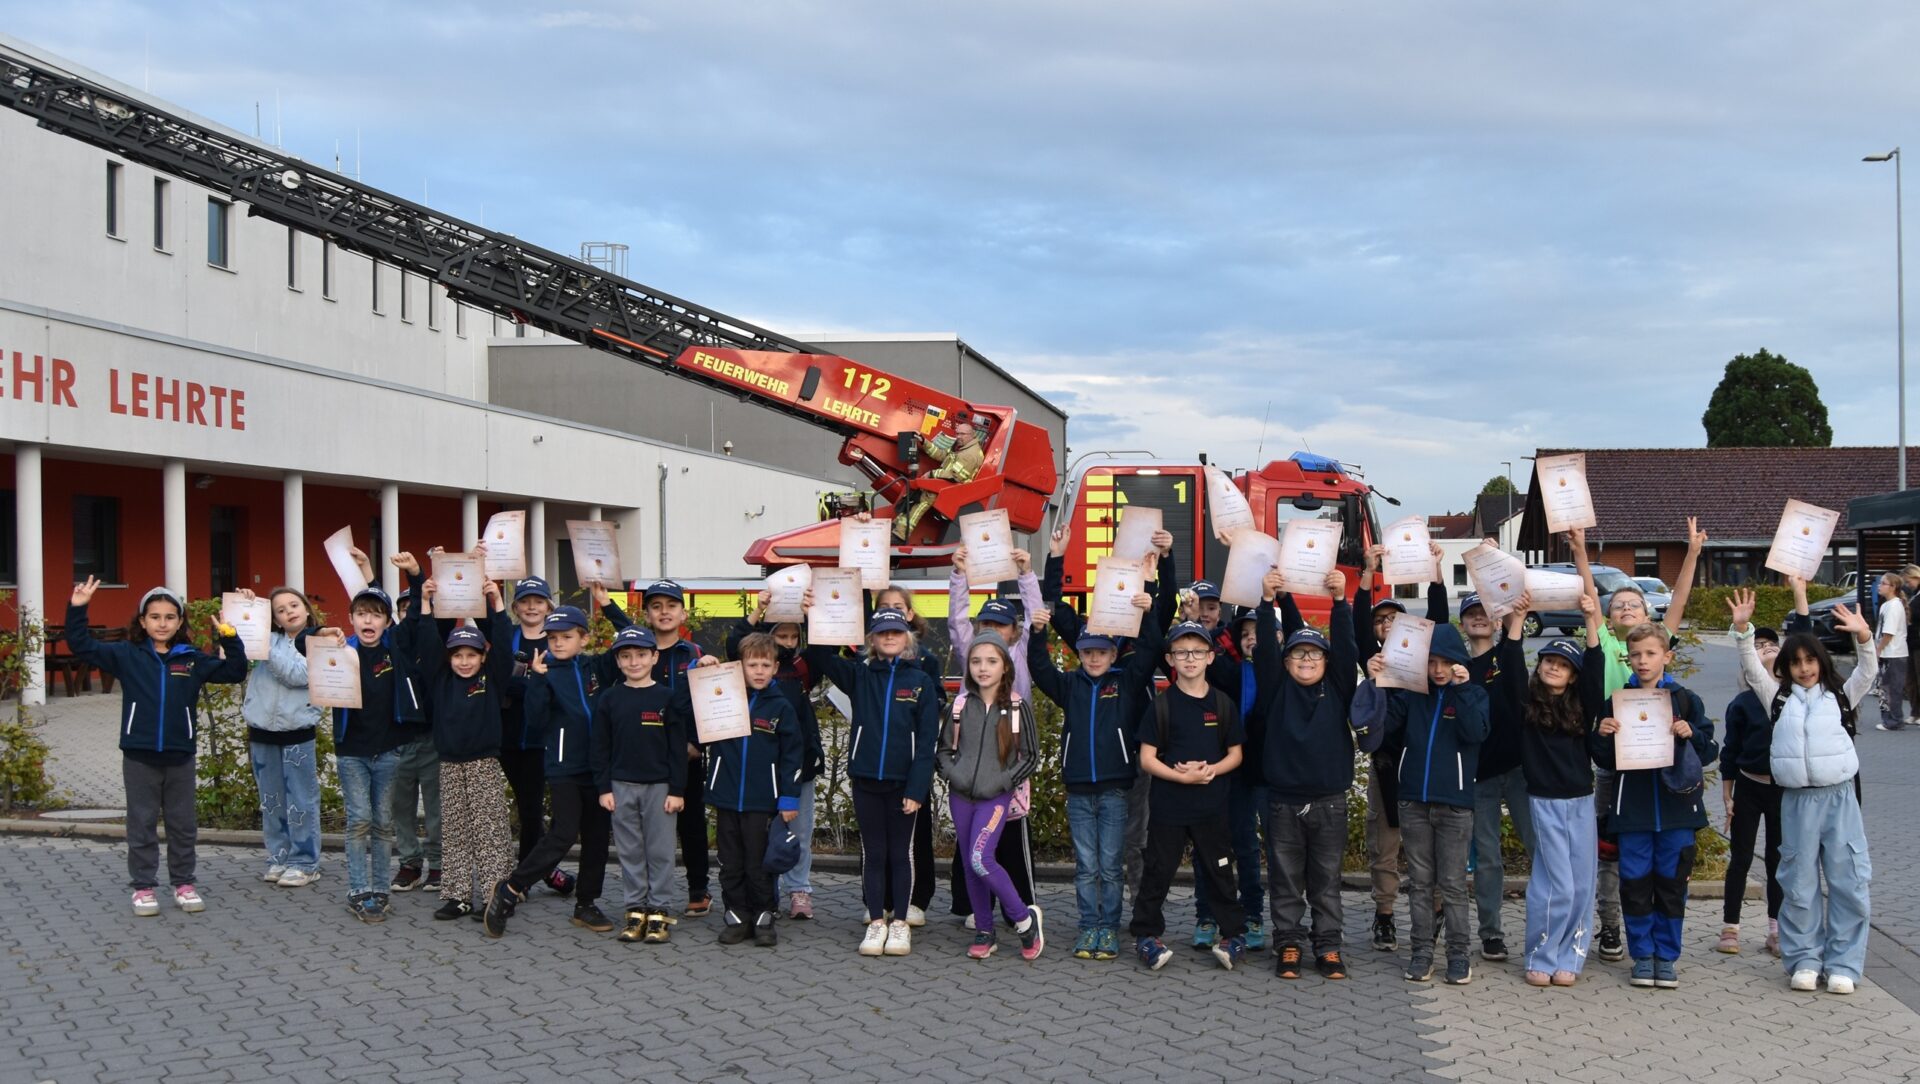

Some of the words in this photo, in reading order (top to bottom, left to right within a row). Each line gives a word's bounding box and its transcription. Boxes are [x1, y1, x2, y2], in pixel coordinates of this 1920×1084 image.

[693, 351, 789, 396] FEUERWEHR
[843, 367, 891, 401] 112
[110, 368, 246, 431] LEHRTE
[823, 396, 881, 428] LEHRTE
[1173, 481, 1187, 504] 1
